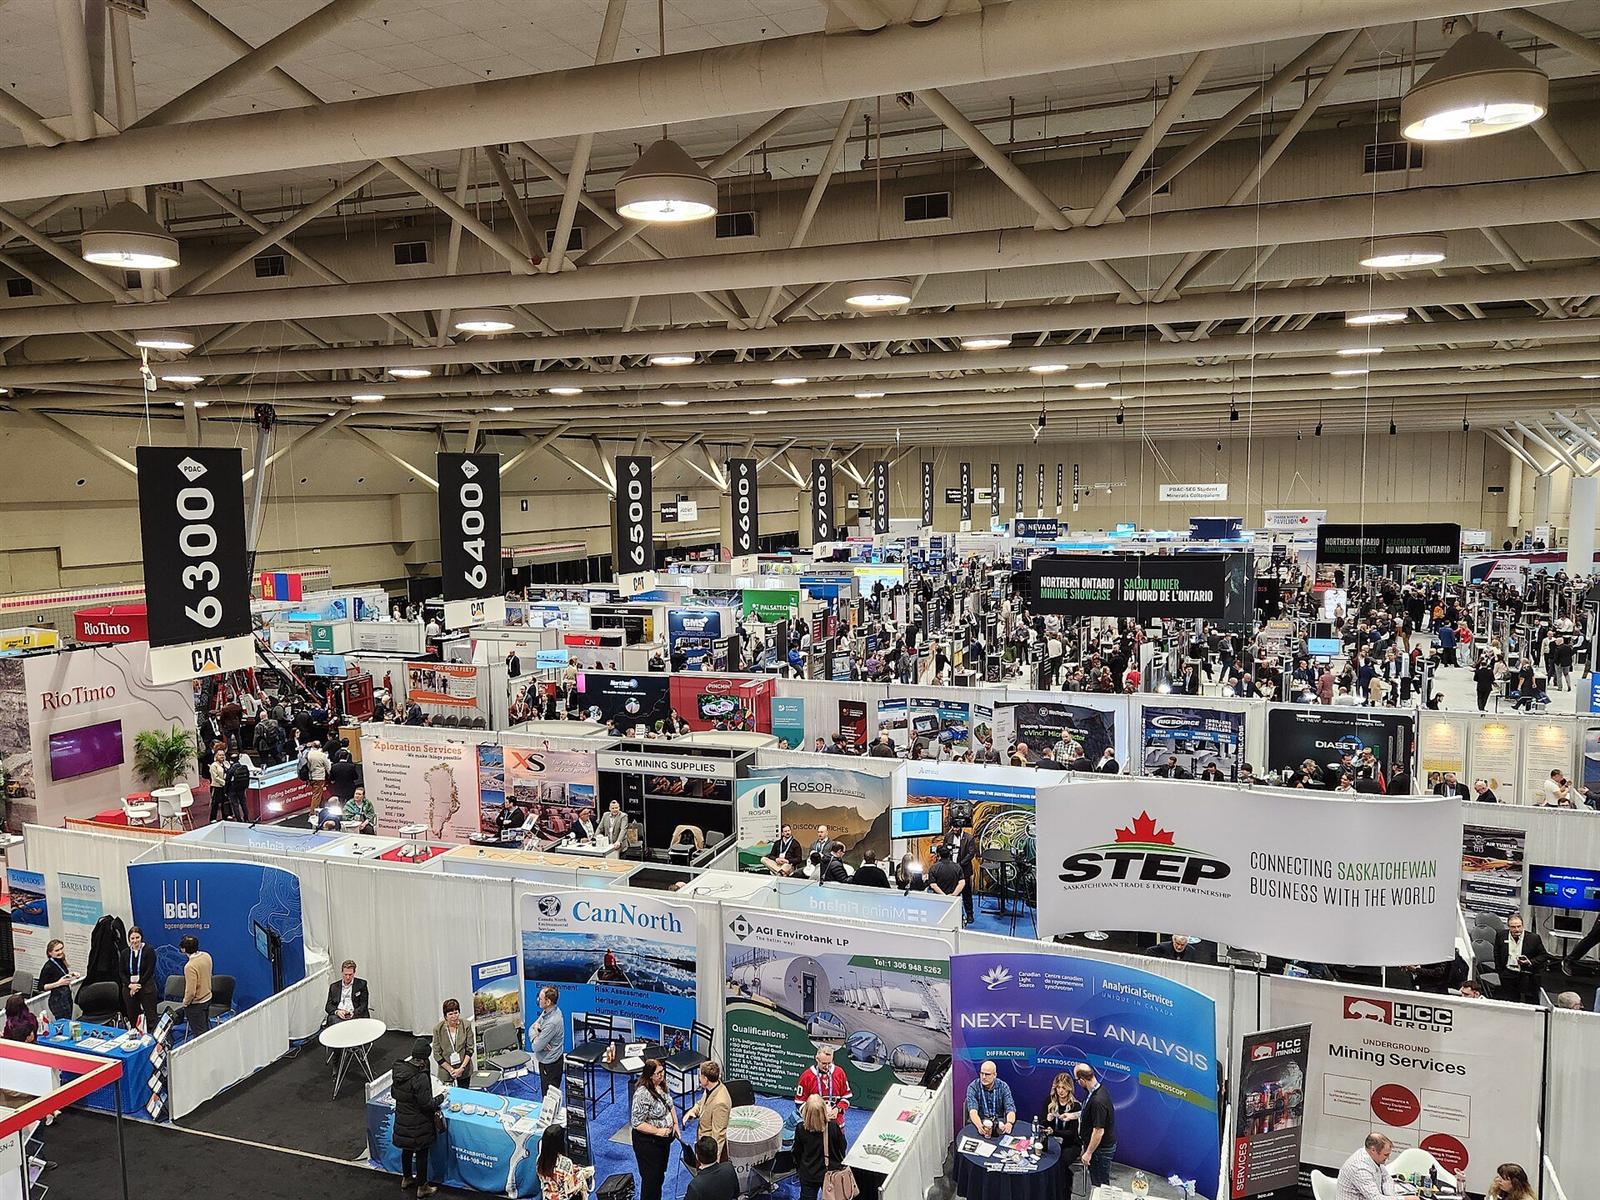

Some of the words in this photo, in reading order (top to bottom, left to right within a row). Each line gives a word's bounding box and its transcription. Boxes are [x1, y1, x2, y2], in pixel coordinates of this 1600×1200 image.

[739, 479, 750, 550] 6600
[818, 476, 828, 538] 6700
[628, 480, 645, 566] 6500
[460, 483, 488, 590] 6400
[1325, 538, 1354, 546] NORTHERN
[1356, 538, 1380, 546] ONTARIO
[1386, 546, 1395, 554] DU
[1396, 546, 1412, 554] NORD
[1412, 546, 1420, 554] DE
[1421, 545, 1451, 554] L'ONTARIO
[176, 487, 224, 629] 6300
[1041, 577, 1079, 589] NORTHERN
[1082, 577, 1115, 589] ONTARIO
[1124, 579, 1150, 590] SALON
[1152, 579, 1180, 590] MINIER
[1041, 588, 1068, 600] MINING
[1070, 589, 1111, 601] SHOWCASE
[1124, 590, 1135, 601] DU
[1136, 590, 1158, 602] NORD
[1160, 591, 1171, 602] DE
[1173, 591, 1213, 602] L'ONTARIO
[471, 602, 485, 617] CAT
[192, 646, 222, 672] CAT
[374, 742, 421, 752] Xploration
[424, 745, 462, 755] Services
[1316, 741, 1359, 750] DIASET
[615, 758, 633, 767] STG
[635, 759, 669, 770] MINING
[671, 761, 716, 773] SUPPLIES
[267, 791, 284, 800] Finding
[284, 787, 298, 795] better
[790, 782, 833, 792] ROSOR
[792, 825, 820, 833] DISCOVE
[827, 825, 849, 833] RICHES
[1059, 852, 1231, 886] STEP
[1250, 851, 1332, 879] CONNECTING
[1338, 860, 1437, 882] SASKATCHEWAN
[61, 881, 96, 892] BARBADOS
[1064, 883, 1121, 891] SASKATCHEWAN
[1153, 884, 1181, 892] EXPORT
[1183, 887, 1232, 899] PARTNERSHIP
[1250, 877, 1318, 903] BUSINESS
[1324, 887, 1359, 907] WITH
[1365, 889, 1386, 907] THE
[1392, 886, 1436, 906] WORLD
[573, 901, 683, 933] CanNorth
[756, 926, 773, 936] AGI
[777, 929, 833, 945] Envirotank
[837, 939, 849, 947] LP
[874, 958, 892, 968] Tel:1
[894, 961, 906, 970] 306
[908, 962, 922, 972] 948
[924, 964, 942, 975] 5262
[1044, 984, 1074, 992] synchrotron
[1052, 979, 1084, 988] rayonnement
[611, 987, 649, 999] Assessment
[1103, 979, 1141, 997] Analytical
[1143, 990, 1174, 1008] Services
[596, 997, 623, 1006] Heritage
[627, 1000, 666, 1014] Archaeology
[1102, 992, 1130, 1003] UNIQUE
[1145, 1003, 1174, 1017] CANADA
[596, 1007, 618, 1015] Human
[620, 1010, 659, 1021] Environment
[1395, 1004, 1452, 1024] HCC
[732, 1024, 789, 1039] Qualifications:
[1394, 1020, 1452, 1033] GROUP
[742, 1039, 765, 1047] Indigenous
[961, 1013, 1097, 1036] NEXT-LEVEL
[1103, 1024, 1209, 1071] ANALYSIS
[1276, 1039, 1301, 1050] HCC
[1363, 1038, 1430, 1054] UNDERGROUND
[787, 1051, 815, 1059] Management
[1275, 1047, 1301, 1057] MINING
[1037, 1058, 1079, 1067] SPECTROSCOP
[1104, 1060, 1131, 1072] IMAGING
[1329, 1044, 1385, 1067] Mining
[1389, 1054, 1466, 1076] Services
[1150, 1079, 1187, 1097] MICROSCOPY
[1236, 1143, 1248, 1191] SERVICES
